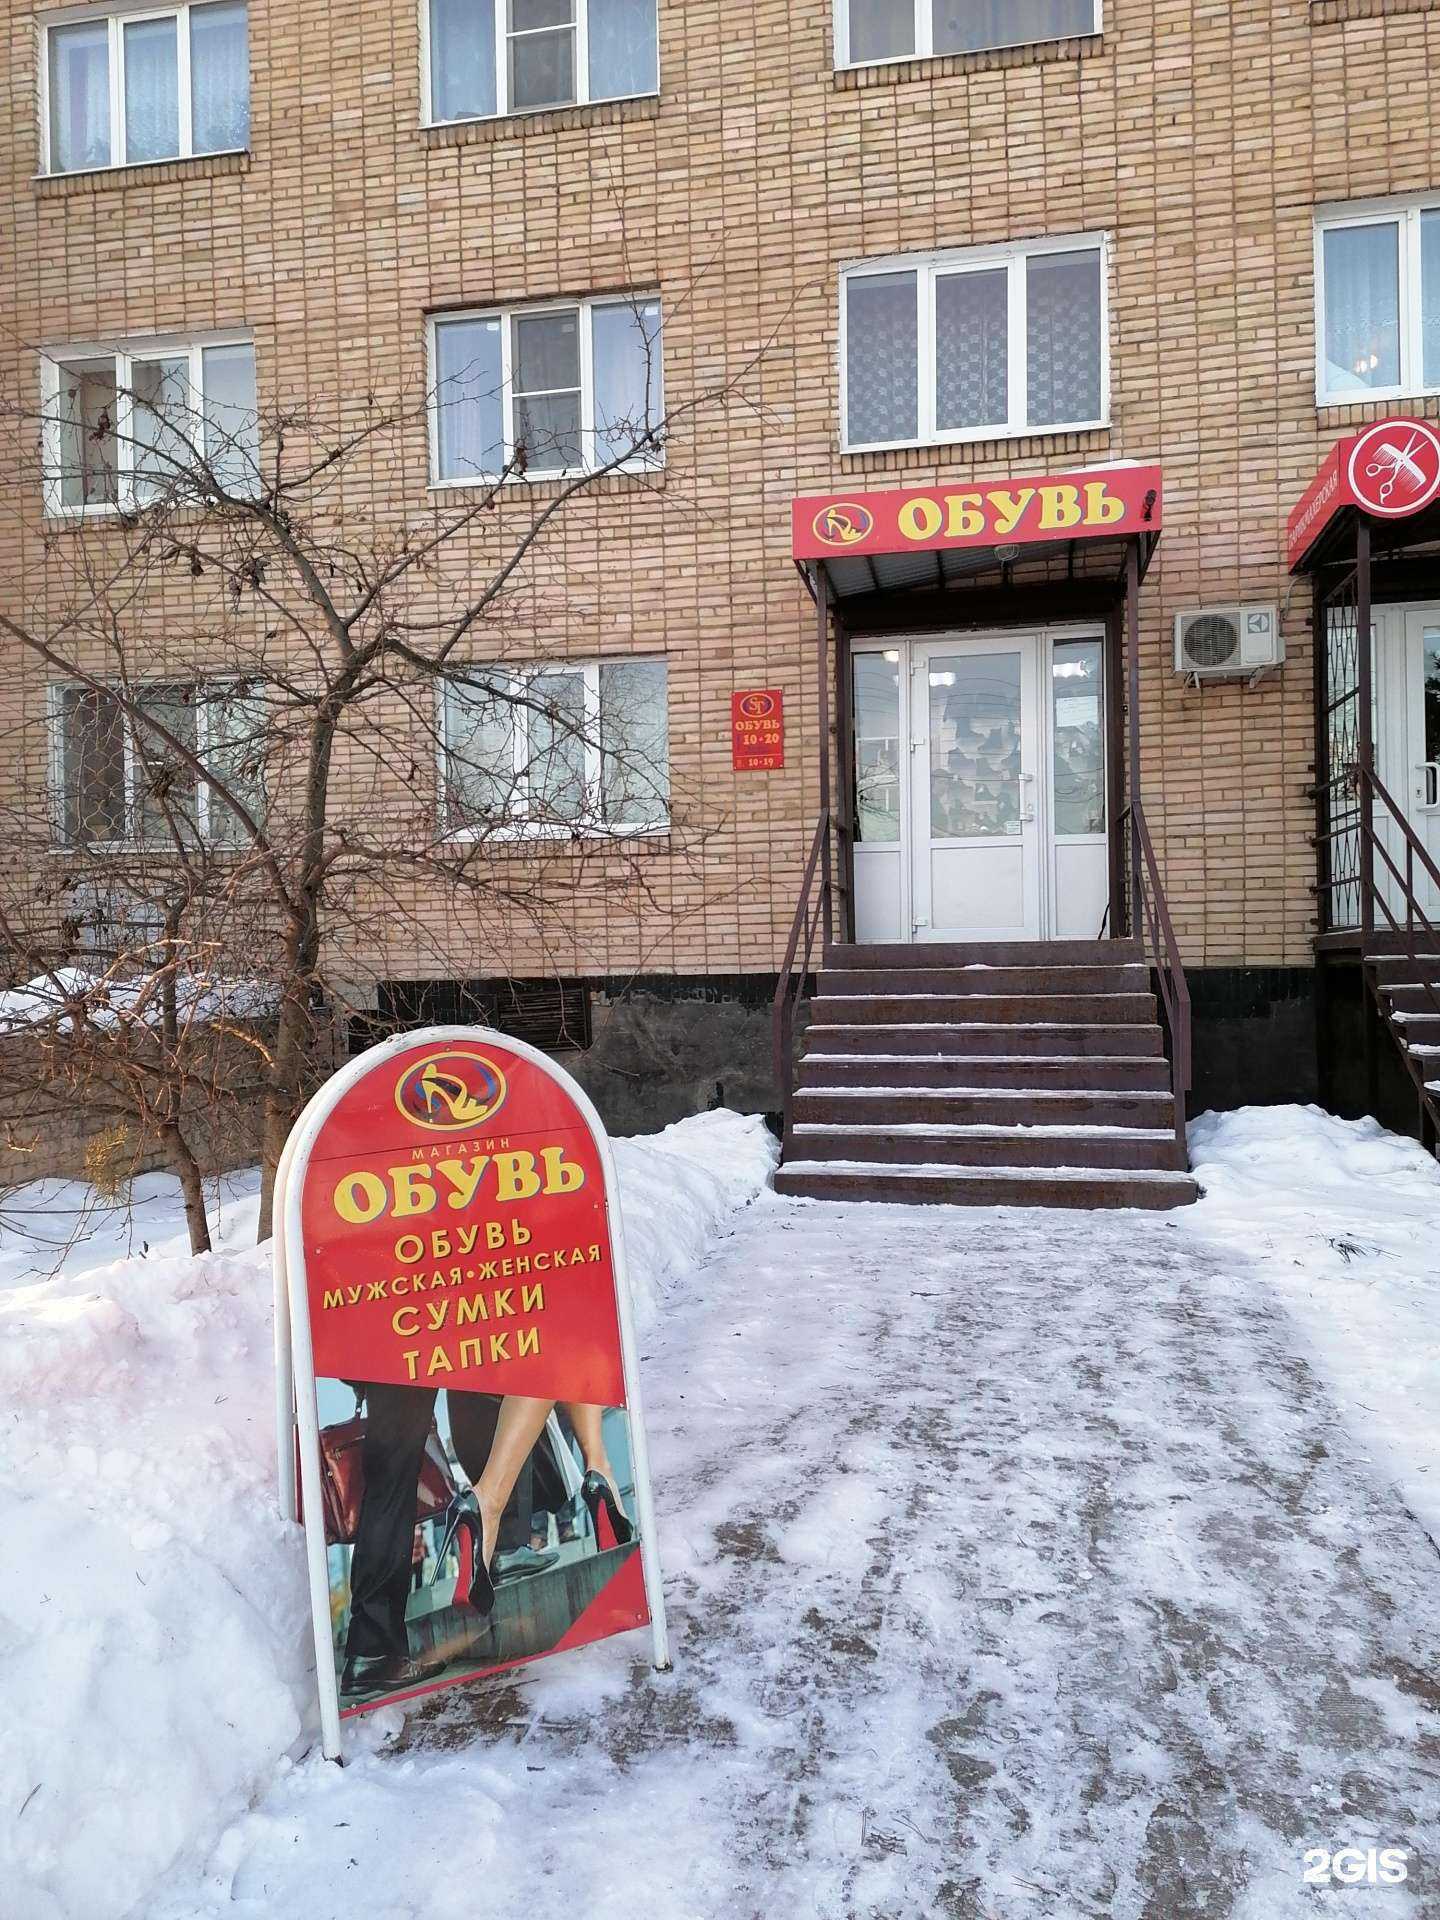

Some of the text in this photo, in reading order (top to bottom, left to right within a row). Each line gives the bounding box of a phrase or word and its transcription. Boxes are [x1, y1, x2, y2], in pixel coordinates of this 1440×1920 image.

[898, 482, 1126, 541] ОБУВЬ
[735, 719, 780, 731] ОБУВЬ
[412, 1138, 510, 1160] МАГАЗИН
[333, 1147, 585, 1224] ОБУВЬ
[394, 1218, 533, 1264] ОБУВЬ
[391, 1283, 545, 1337] СУМКИ
[402, 1326, 542, 1381] ТАПКИ
